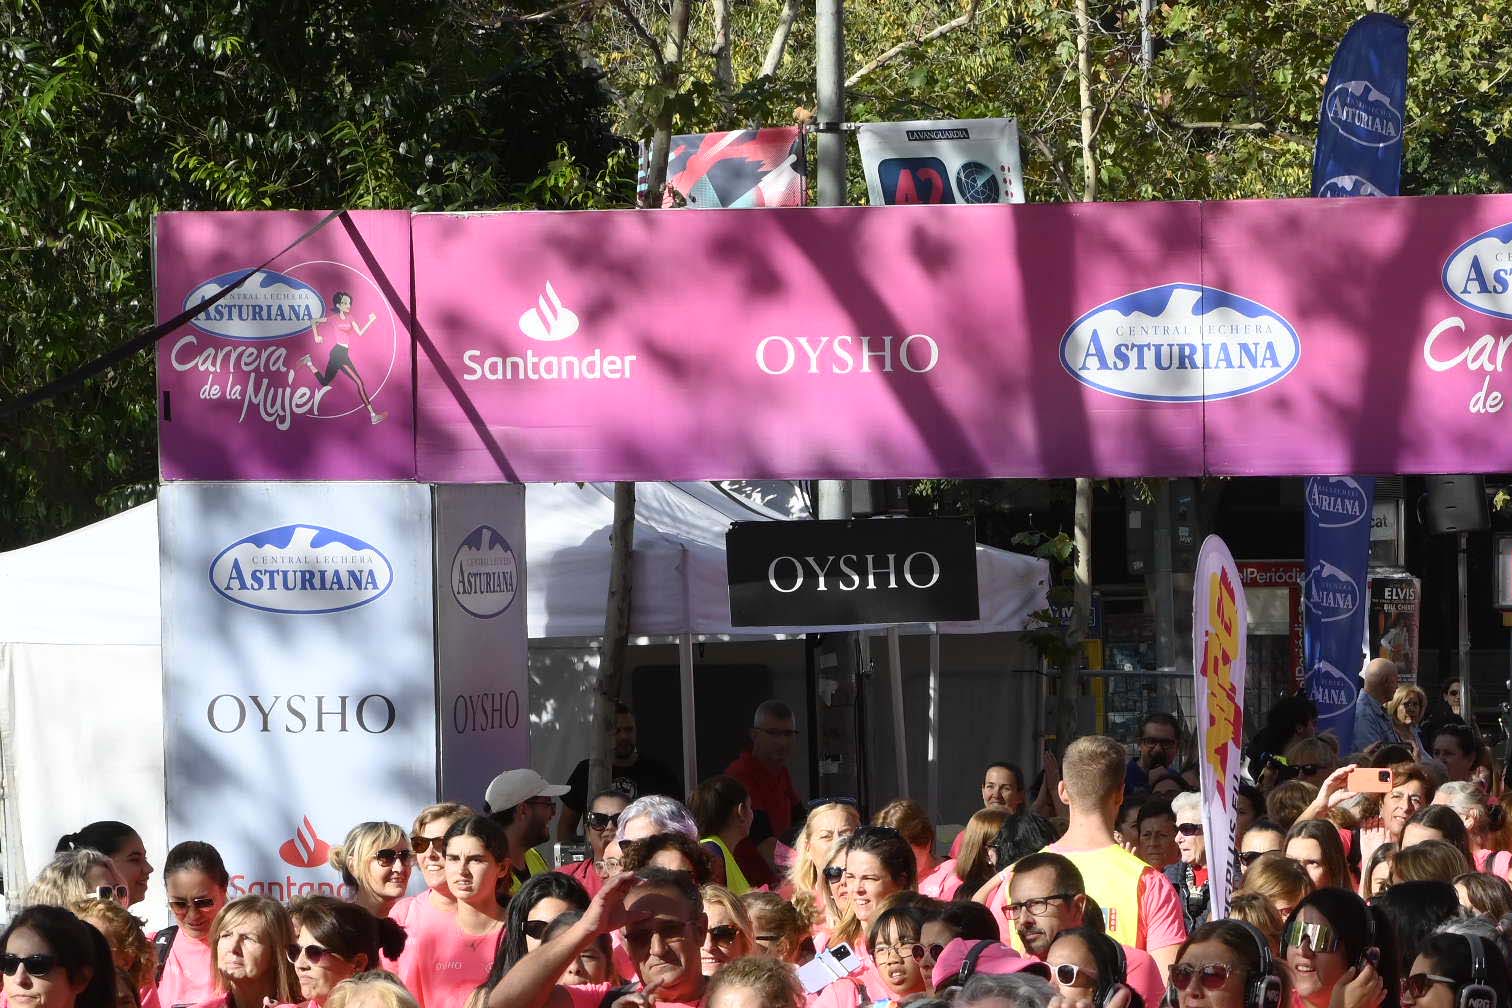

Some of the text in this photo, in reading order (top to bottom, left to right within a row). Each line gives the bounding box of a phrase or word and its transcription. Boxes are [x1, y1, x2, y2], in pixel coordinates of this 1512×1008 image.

[917, 128, 968, 140] VANGUARDIA
[194, 295, 313, 322] ASTURIANA
[1115, 323, 1193, 337] CENTRAL
[171, 335, 288, 373] Carrera
[463, 349, 636, 381] Santander
[756, 333, 939, 374] OYSHO
[1078, 328, 1281, 371] ASTURIANA
[200, 369, 332, 430] de la Mujer
[1469, 374, 1504, 414] de
[224, 556, 380, 591] ASTURIANA
[252, 555, 374, 565] CENTRAL LECHERA
[457, 560, 515, 596] ASTURIANA
[768, 550, 941, 594] OYSHO
[1384, 587, 1415, 601] ELVIS
[207, 694, 396, 734] OYSHO
[454, 690, 519, 734] OYSHO
